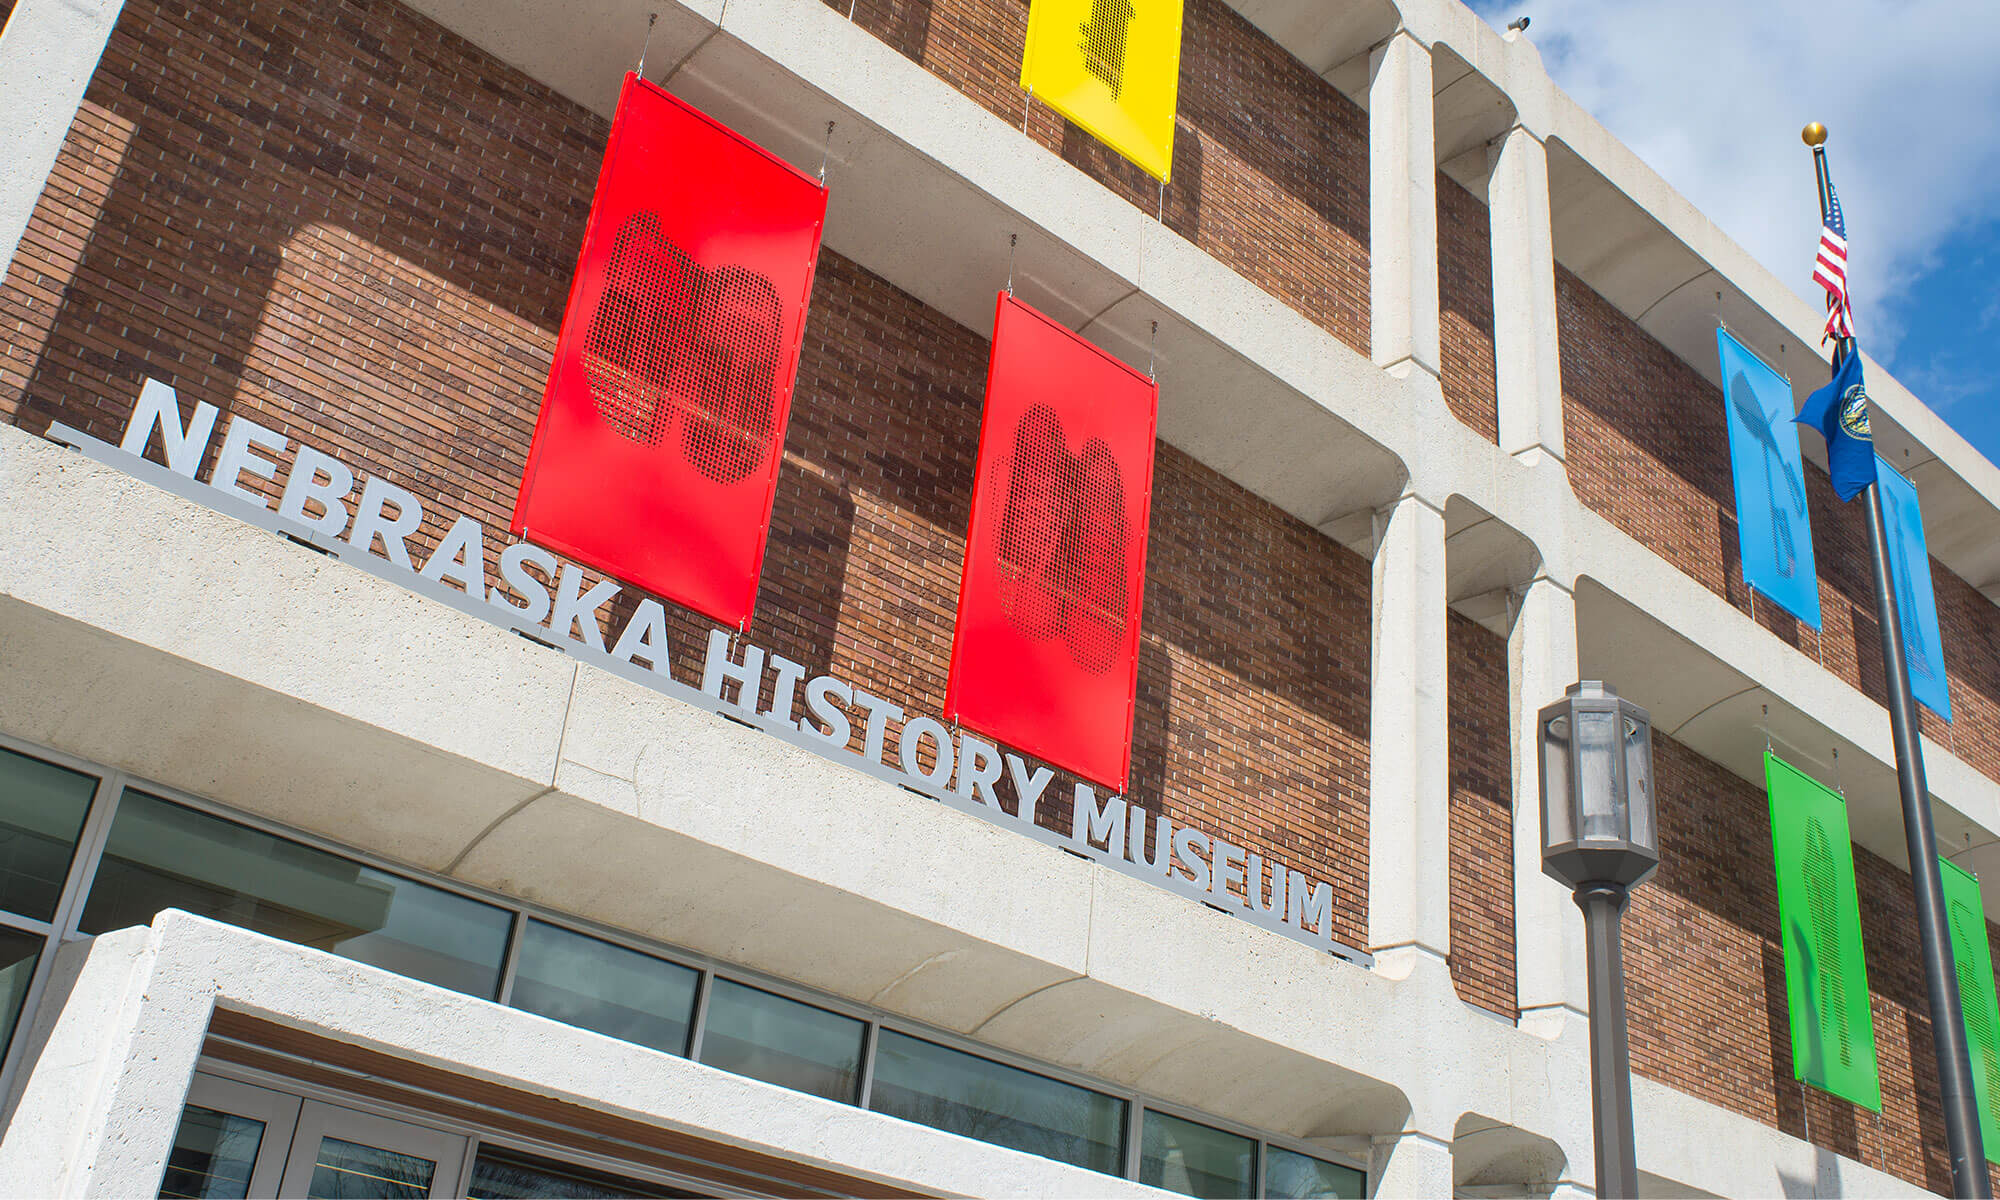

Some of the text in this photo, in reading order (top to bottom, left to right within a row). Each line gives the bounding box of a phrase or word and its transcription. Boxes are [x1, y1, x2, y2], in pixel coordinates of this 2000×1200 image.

[120, 377, 1333, 939] NEBRASKA HISTORY MUSEUM
